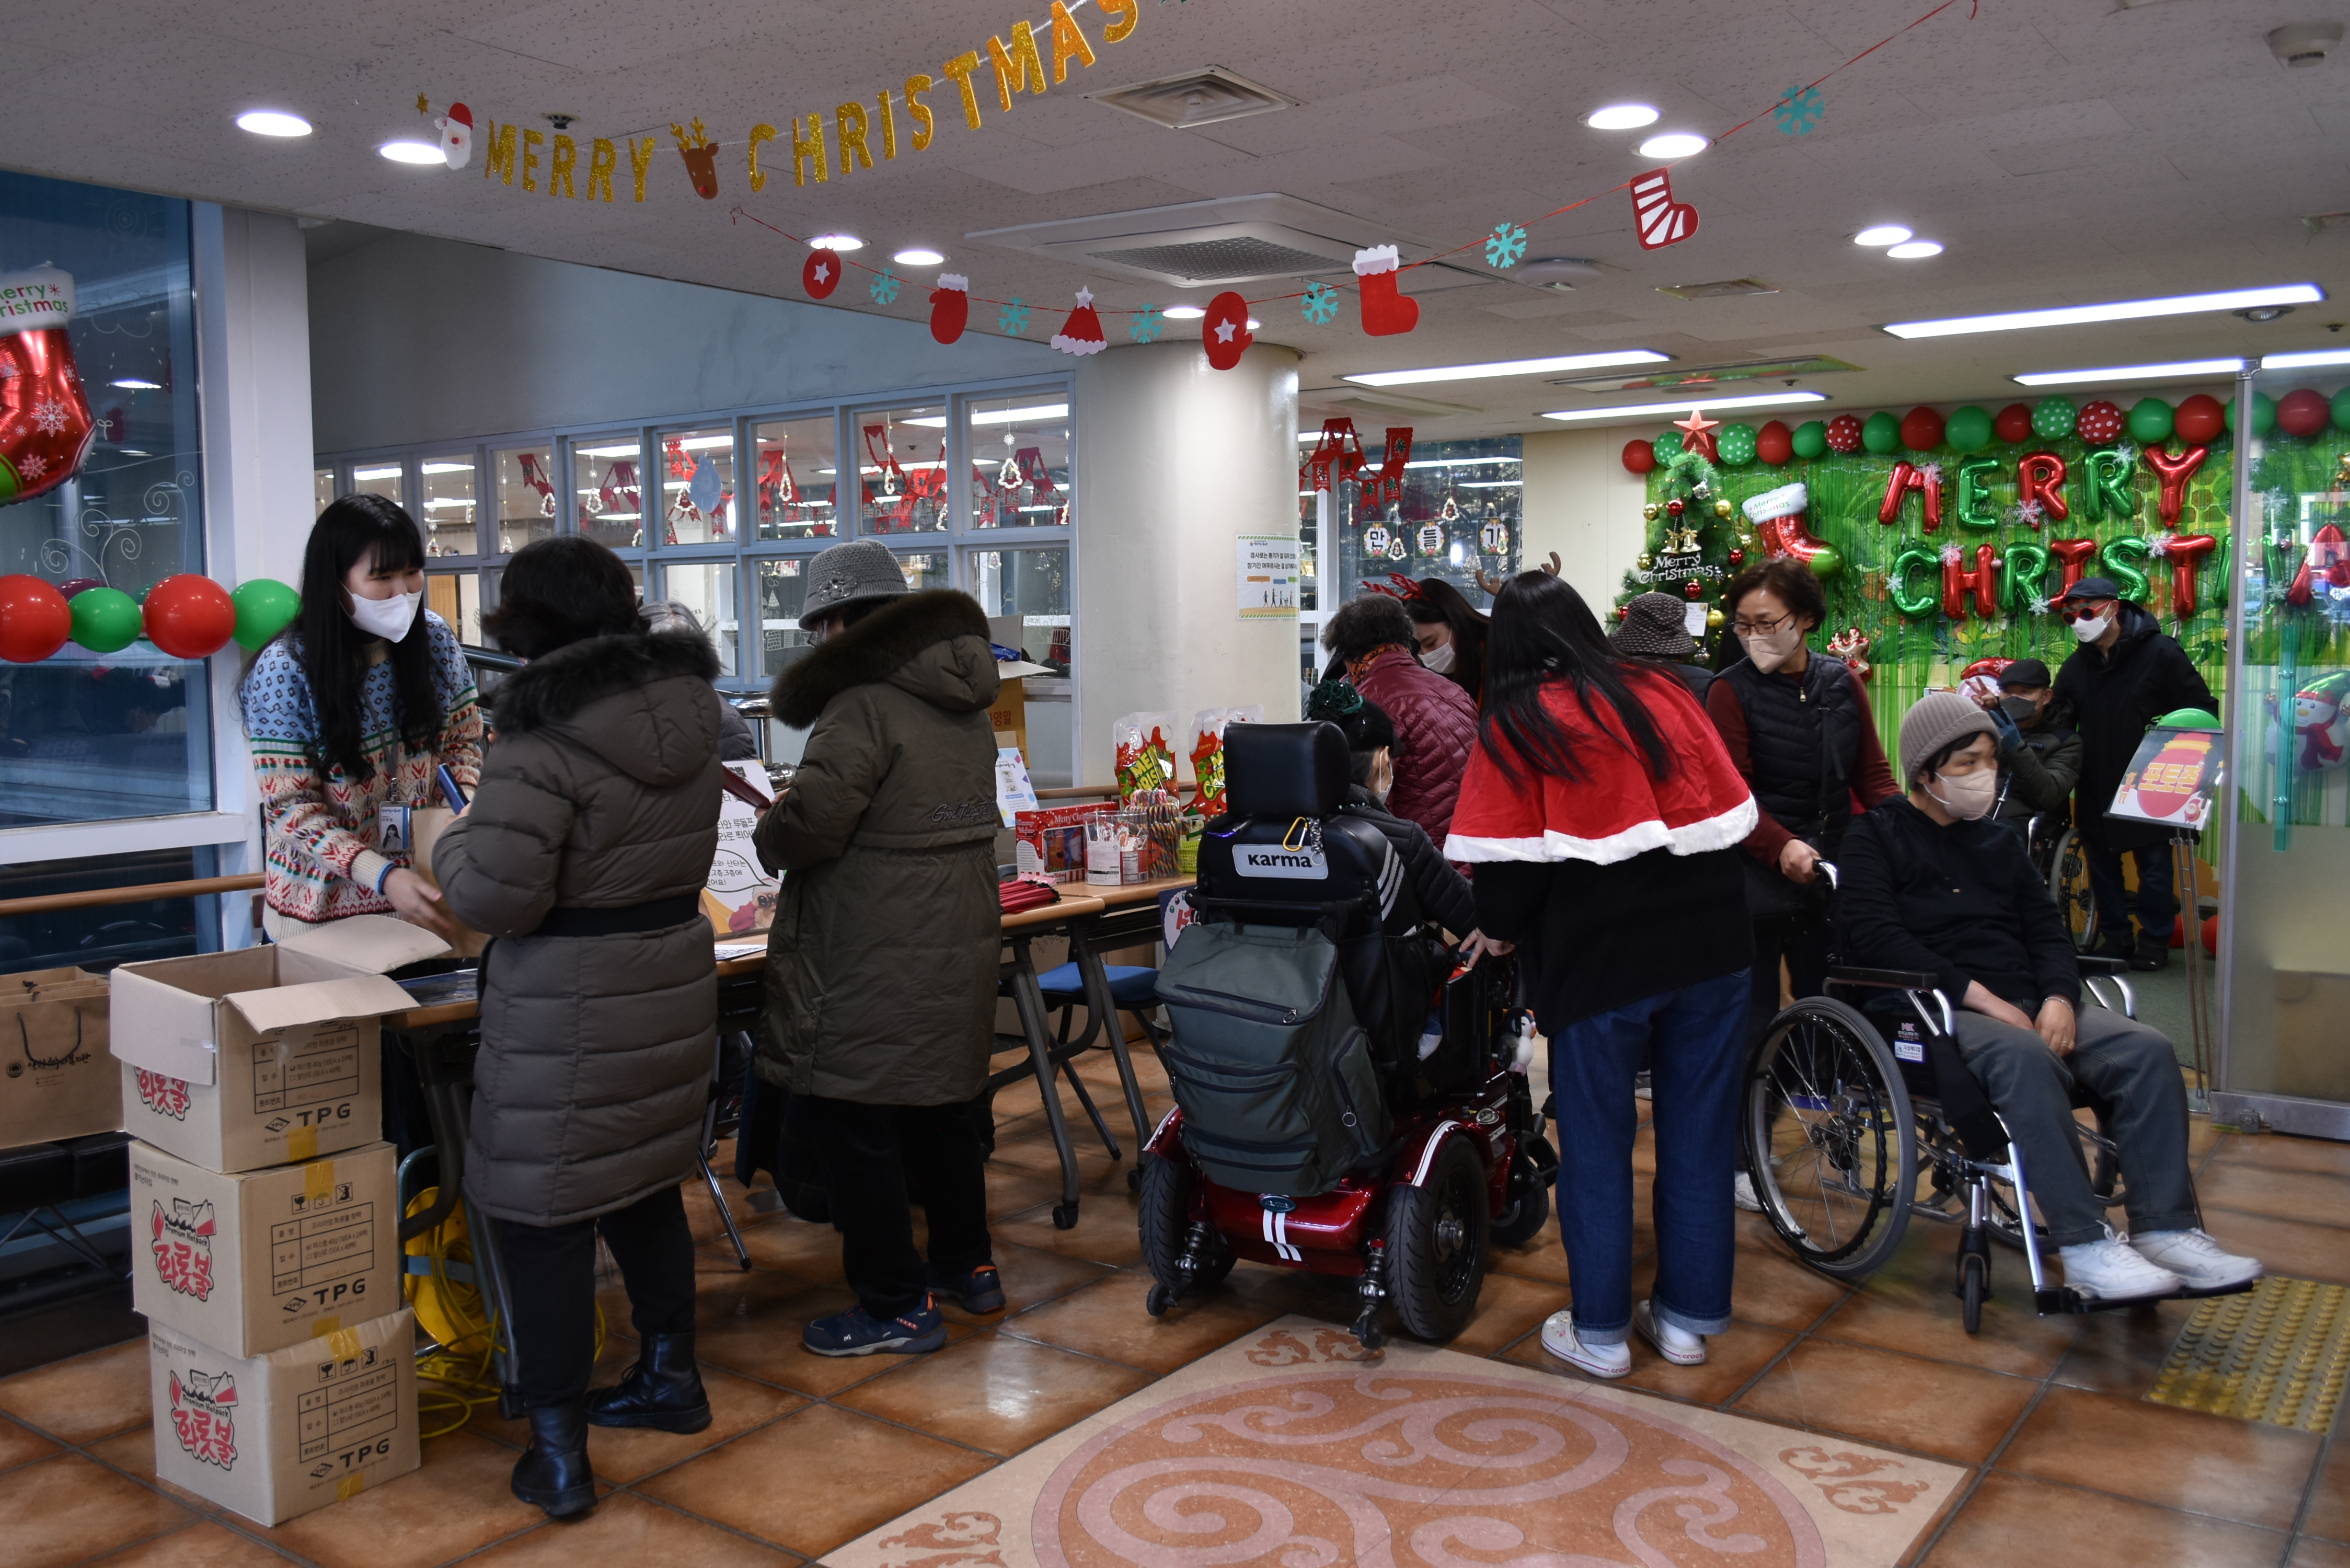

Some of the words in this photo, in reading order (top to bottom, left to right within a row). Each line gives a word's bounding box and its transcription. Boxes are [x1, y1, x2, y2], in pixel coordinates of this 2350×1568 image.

[485, 119, 655, 203] MERRY
[748, 0, 1139, 193] CHRISTMAS
[0, 285, 44, 300] erry
[1878, 442, 2209, 536] MERRY
[1653, 552, 1701, 569] Merry
[717, 820, 732, 829] 타와
[733, 817, 756, 828] 루돌프
[932, 802, 961, 822] Good
[1054, 814, 1072, 824] Merry
[717, 831, 735, 841] 라로
[726, 859, 746, 868] 산타는
[296, 1103, 351, 1127] TPG
[165, 1224, 186, 1238] Premium
[187, 1233, 208, 1247] Hotpack
[328, 1237, 338, 1245] 40g
[154, 1241, 212, 1300] 화롯불
[313, 1278, 366, 1305] TPG
[183, 1393, 205, 1409] Premium
[205, 1403, 229, 1418] Hotpack
[173, 1408, 235, 1465] 화롯불
[339, 1438, 389, 1468] TPG
